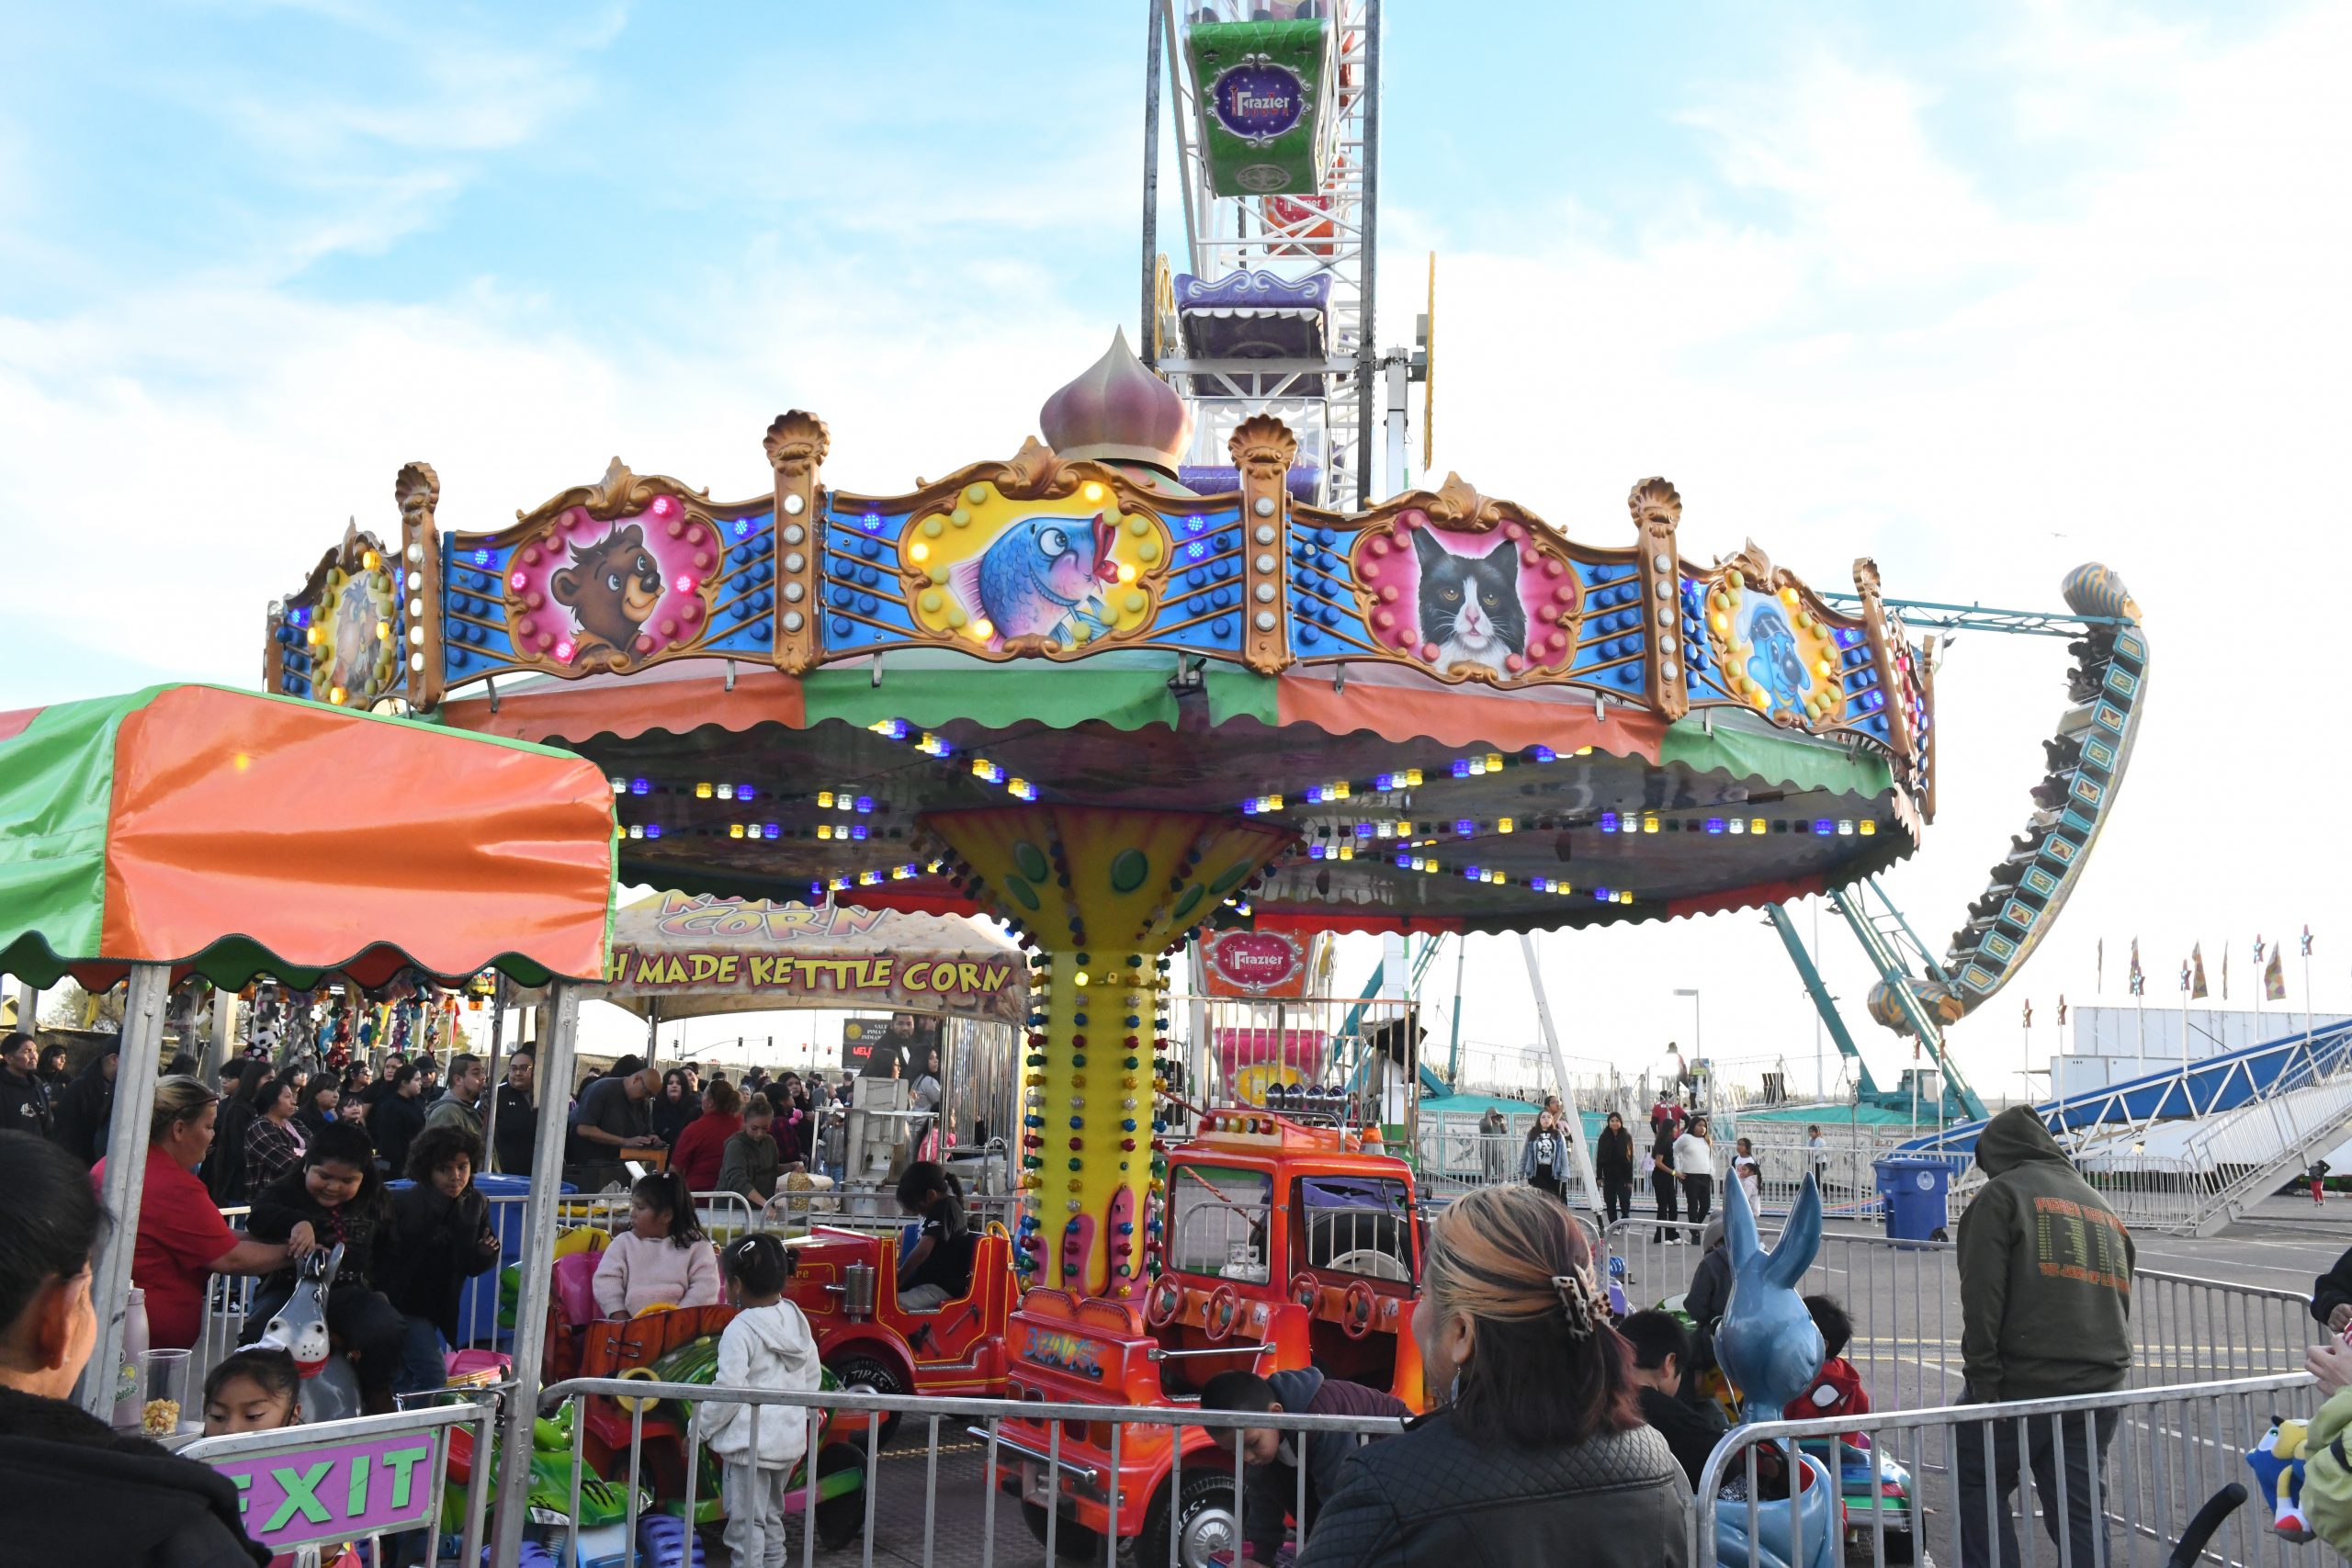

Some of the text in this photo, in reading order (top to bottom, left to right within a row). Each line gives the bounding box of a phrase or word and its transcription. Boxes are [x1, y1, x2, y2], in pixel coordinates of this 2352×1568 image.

[1238, 91, 1290, 117] Frazier
[659, 904, 889, 942] CORN
[635, 953, 740, 985] MADE
[749, 955, 894, 990] KETTLE
[902, 962, 1011, 993] CORN
[1235, 952, 1283, 970] Frazier
[2034, 1198, 2083, 1219] PIERCE
